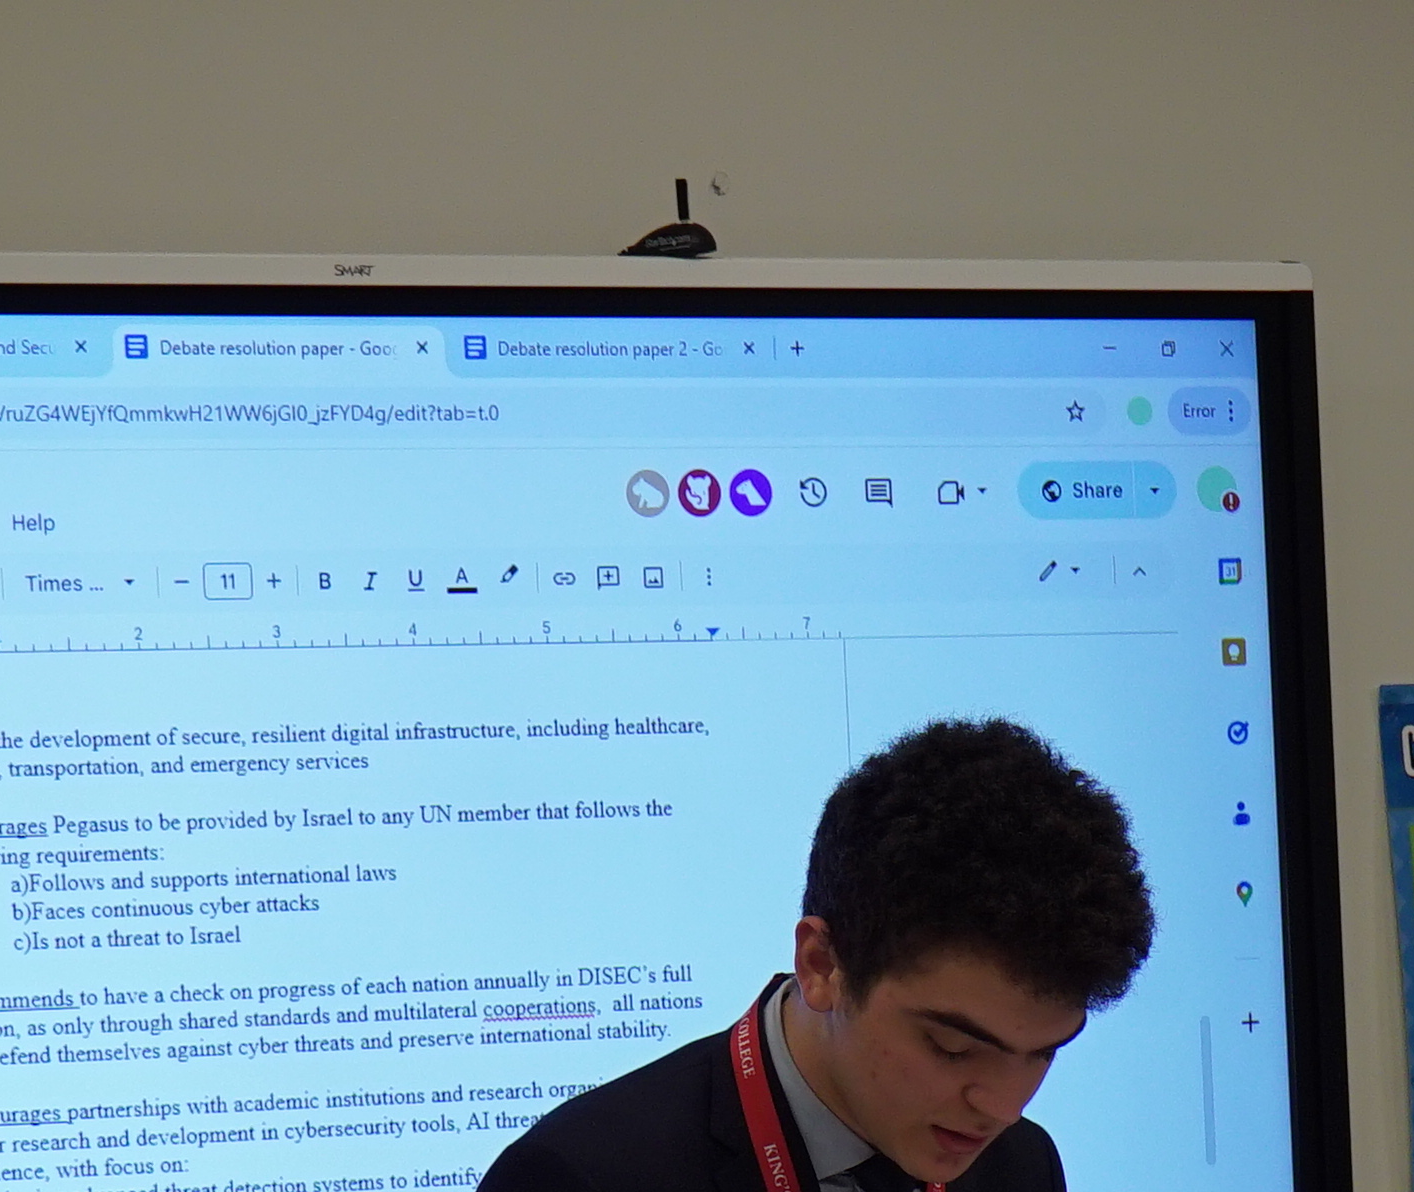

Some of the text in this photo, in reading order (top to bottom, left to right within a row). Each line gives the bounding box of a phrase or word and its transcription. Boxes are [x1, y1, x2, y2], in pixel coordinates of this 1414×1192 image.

[334, 264, 374, 277] SMART
[160, 339, 216, 356] Debate
[220, 340, 297, 356] resolution
[300, 344, 345, 361] paper
[498, 340, 552, 357] Debate
[555, 340, 629, 357] resolution
[632, 345, 675, 362] paper
[678, 340, 688, 357] 2
[1183, 402, 1217, 419] Error
[1072, 480, 1123, 499] Share
[12, 512, 56, 536] Help
[24, 573, 83, 592] Times
[220, 572, 236, 590] 11
[29, 729, 151, 752] development
[156, 726, 179, 746] of
[181, 731, 247, 748] secure,
[251, 724, 327, 744] resilient
[331, 722, 390, 746] digital
[395, 721, 521, 741] infrastructure,
[526, 717, 610, 741] including
[614, 716, 710, 737] healthcare,
[7, 760, 144, 781] transportation,
[150, 754, 185, 774] and
[190, 757, 291, 777] emergency
[296, 750, 369, 771] services
[53, 814, 130, 838] Pegasus
[134, 816, 153, 832] to
[158, 812, 181, 831] be
[186, 809, 268, 835] provided
[273, 809, 297, 832] by
[302, 807, 353, 827] Israel
[357, 811, 376, 826] to
[381, 811, 415, 829] any
[419, 804, 452, 824] UN
[457, 802, 531, 823] member
[535, 802, 570, 820] that
[575, 800, 641, 820] follows
[645, 798, 673, 817] the
[36, 846, 165, 868] requirements:
